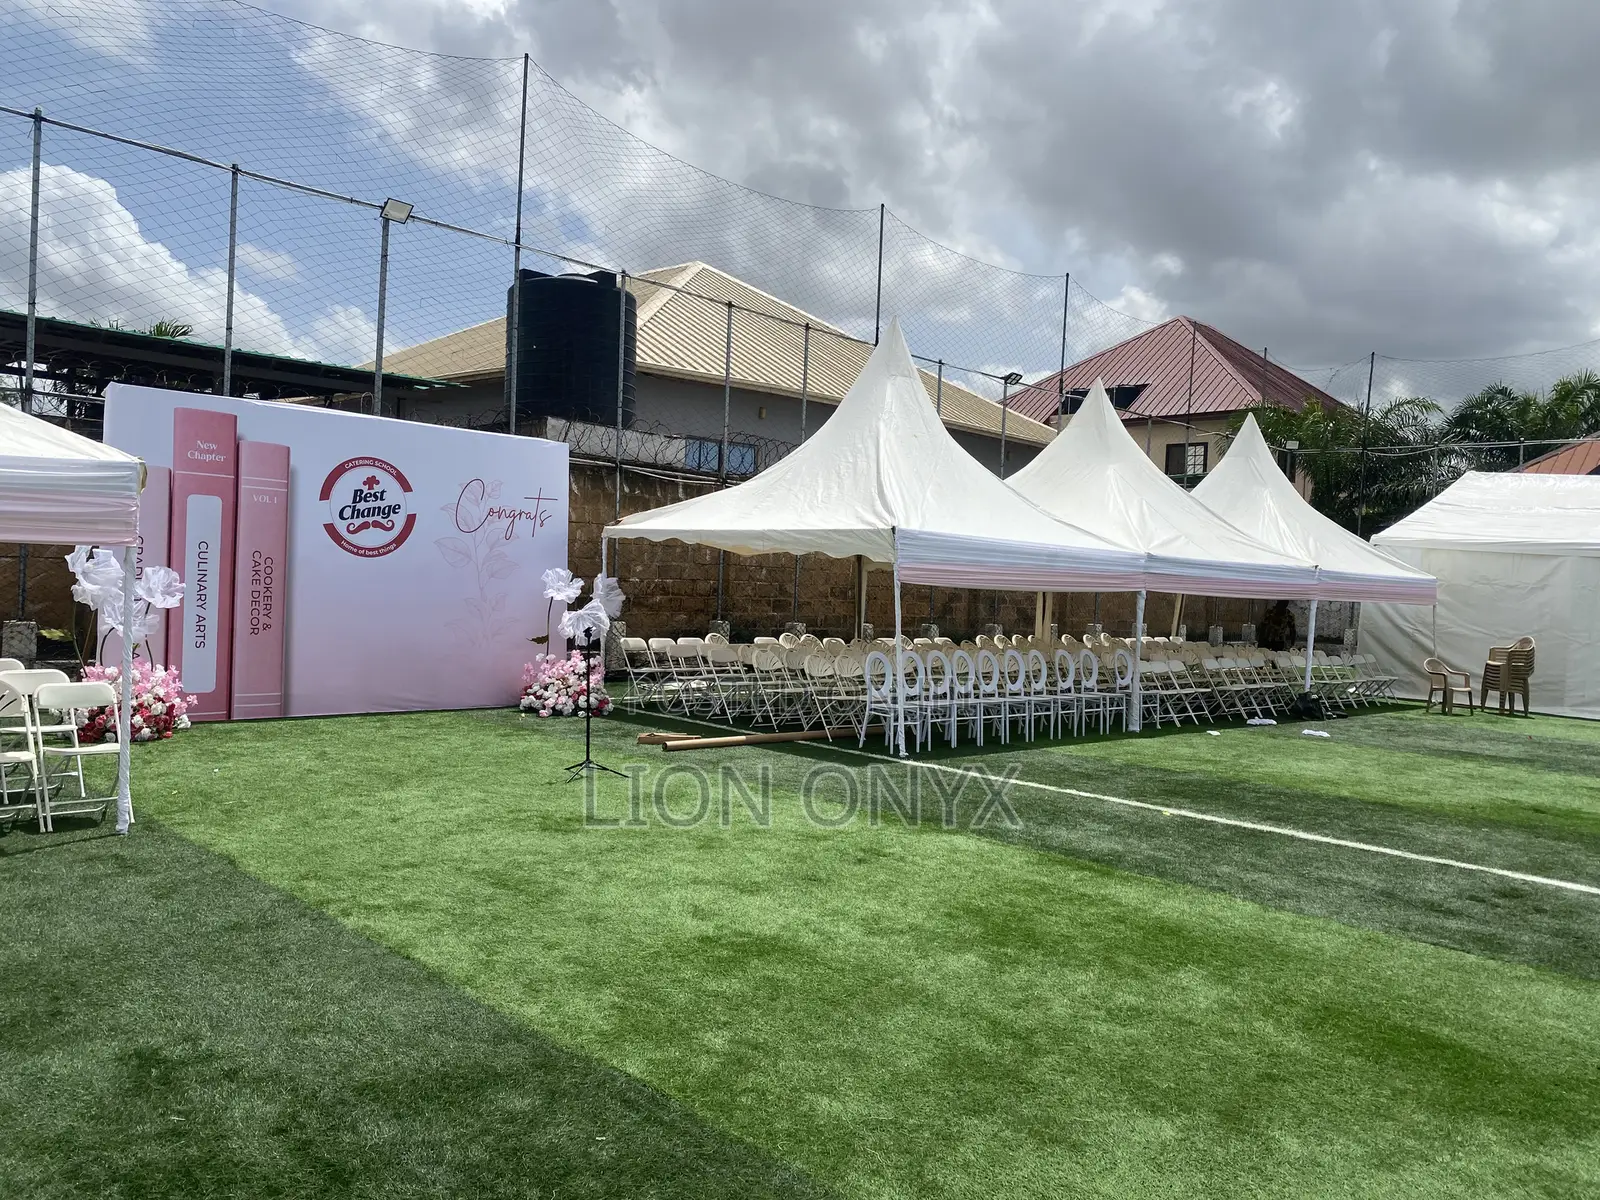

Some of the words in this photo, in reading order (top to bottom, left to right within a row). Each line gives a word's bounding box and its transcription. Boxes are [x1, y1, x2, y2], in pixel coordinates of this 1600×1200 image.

[196, 440, 218, 450] New
[187, 450, 227, 463] Chapter
[345, 460, 374, 469] CATERING
[374, 460, 397, 476] SCHOOL
[252, 494, 272, 504] VOL
[351, 489, 387, 504] Best
[338, 503, 401, 520] Change
[455, 478, 558, 541] Congrats
[340, 540, 358, 553] Home
[379, 543, 397, 555] things
[196, 541, 208, 610] CULINARY
[251, 550, 262, 586] CAKE
[262, 556, 273, 619] COOKERY
[249, 590, 261, 636] DECOR
[194, 614, 206, 648] ARTS
[262, 622, 272, 632] &
